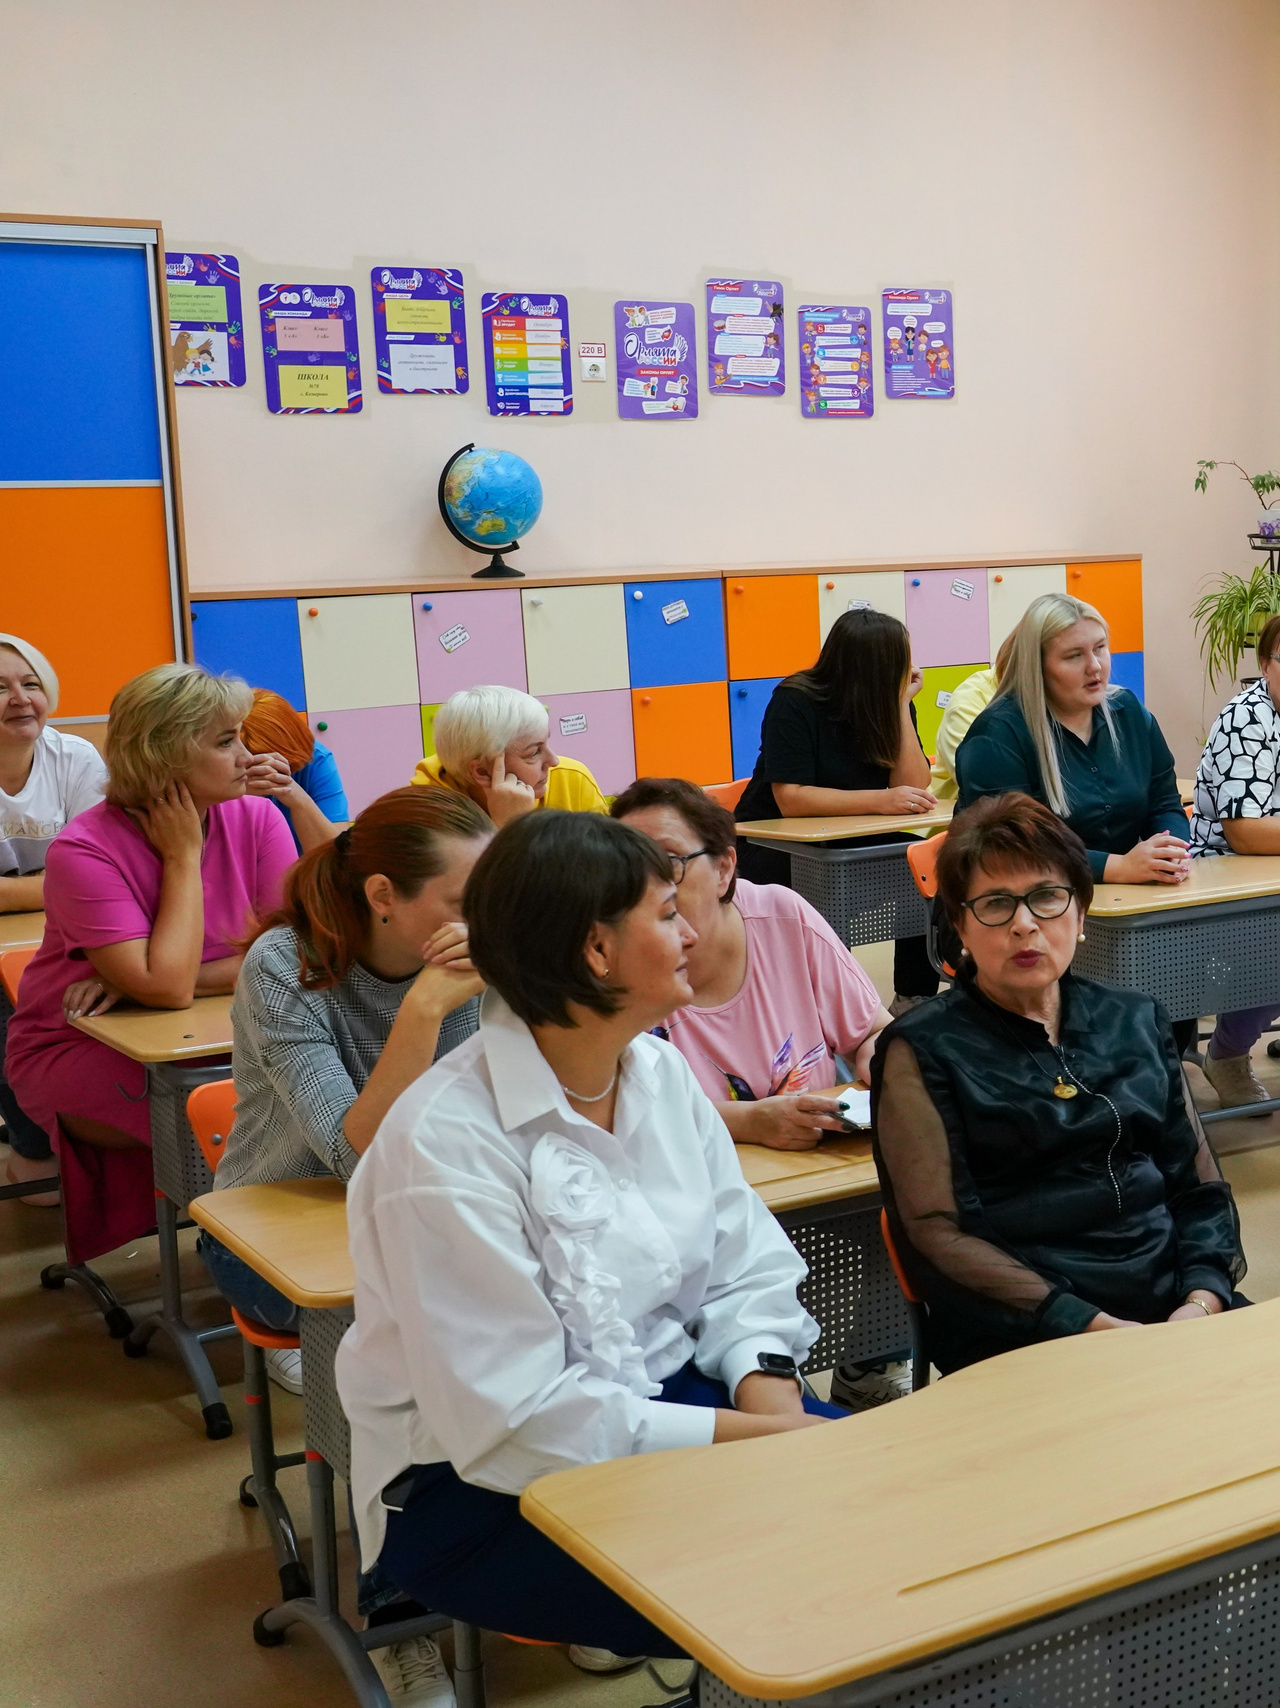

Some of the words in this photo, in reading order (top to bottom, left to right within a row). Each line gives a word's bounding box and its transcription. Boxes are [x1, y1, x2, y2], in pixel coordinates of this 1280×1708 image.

[582, 346, 595, 354] 220
[597, 346, 603, 354] В
[625, 333, 677, 360] Орлята
[638, 356, 677, 365] РОССИИ
[297, 373, 329, 381] ШКОЛА
